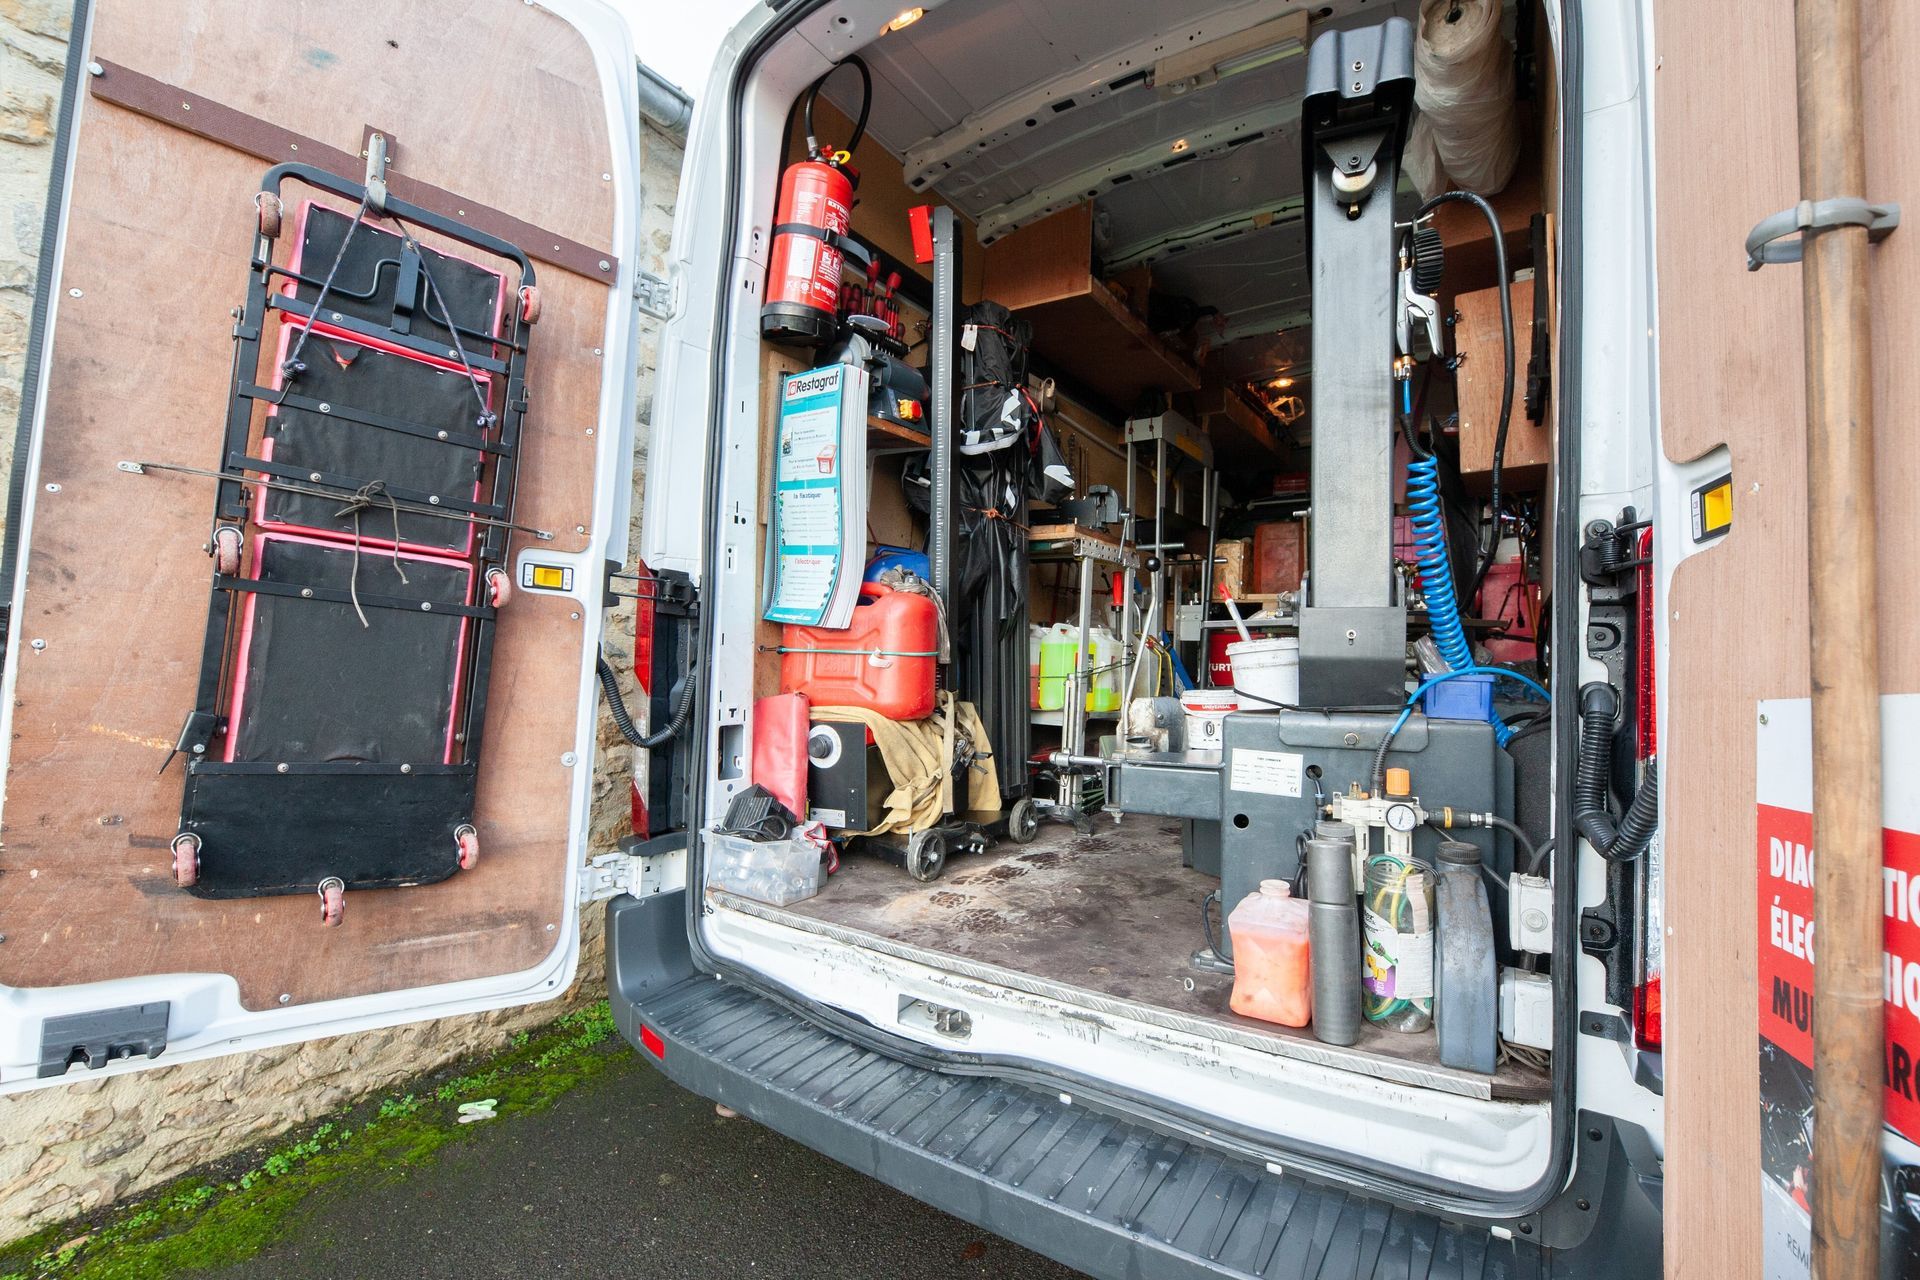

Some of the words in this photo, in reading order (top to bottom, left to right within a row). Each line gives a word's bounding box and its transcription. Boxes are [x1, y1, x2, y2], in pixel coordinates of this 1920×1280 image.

[797, 371, 839, 393] Restagraf
[1209, 663, 1232, 671] ÜRT
[1787, 1232, 1809, 1270] REMI
